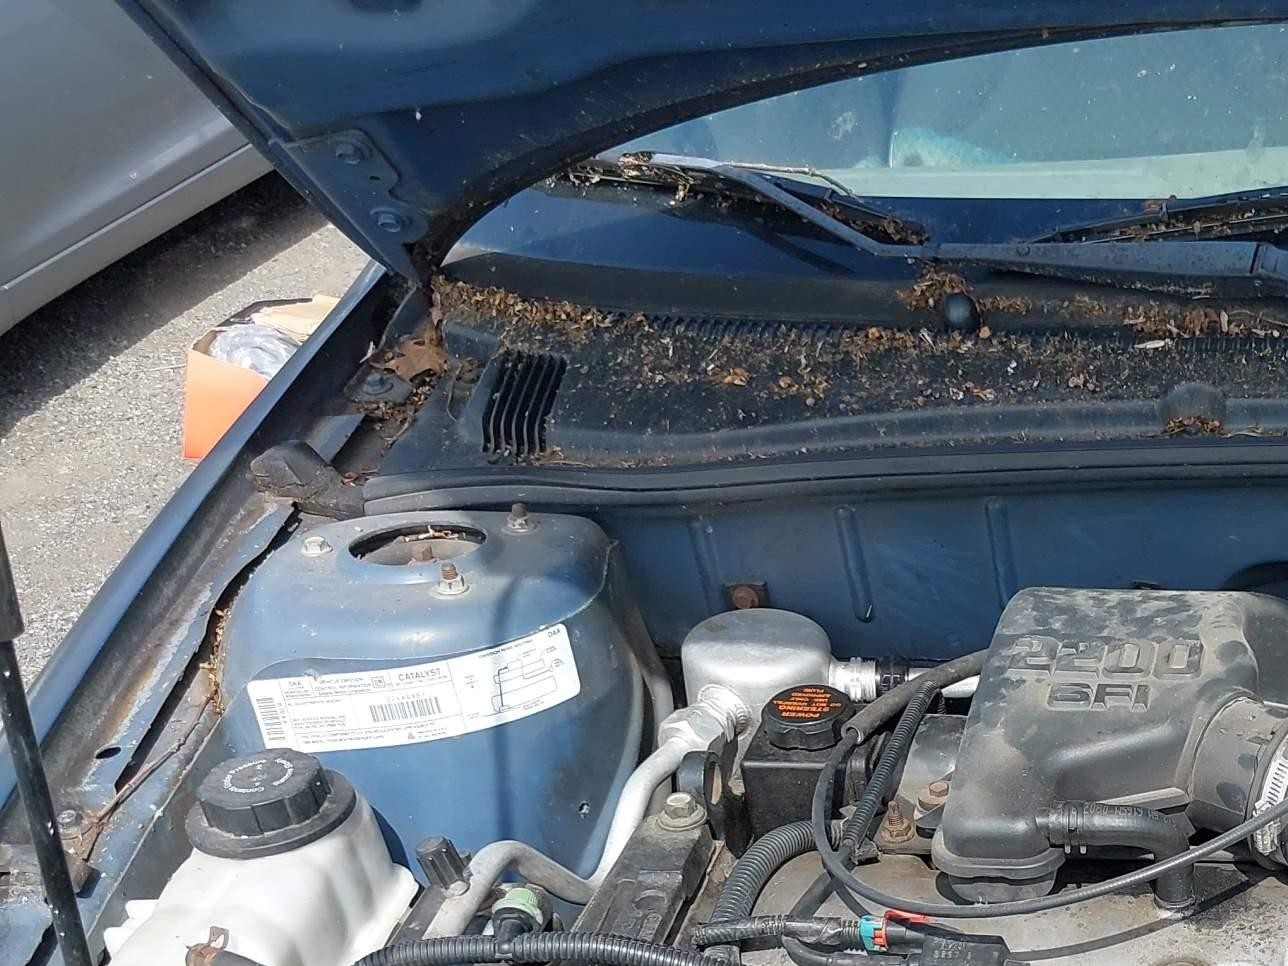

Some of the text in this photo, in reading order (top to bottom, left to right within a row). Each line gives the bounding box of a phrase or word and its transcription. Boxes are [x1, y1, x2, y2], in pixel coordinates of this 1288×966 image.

[1006, 634, 1206, 681] 2200
[398, 668, 442, 682] CATALYST
[778, 704, 831, 712] STEERING
[1046, 682, 1152, 713] SFI
